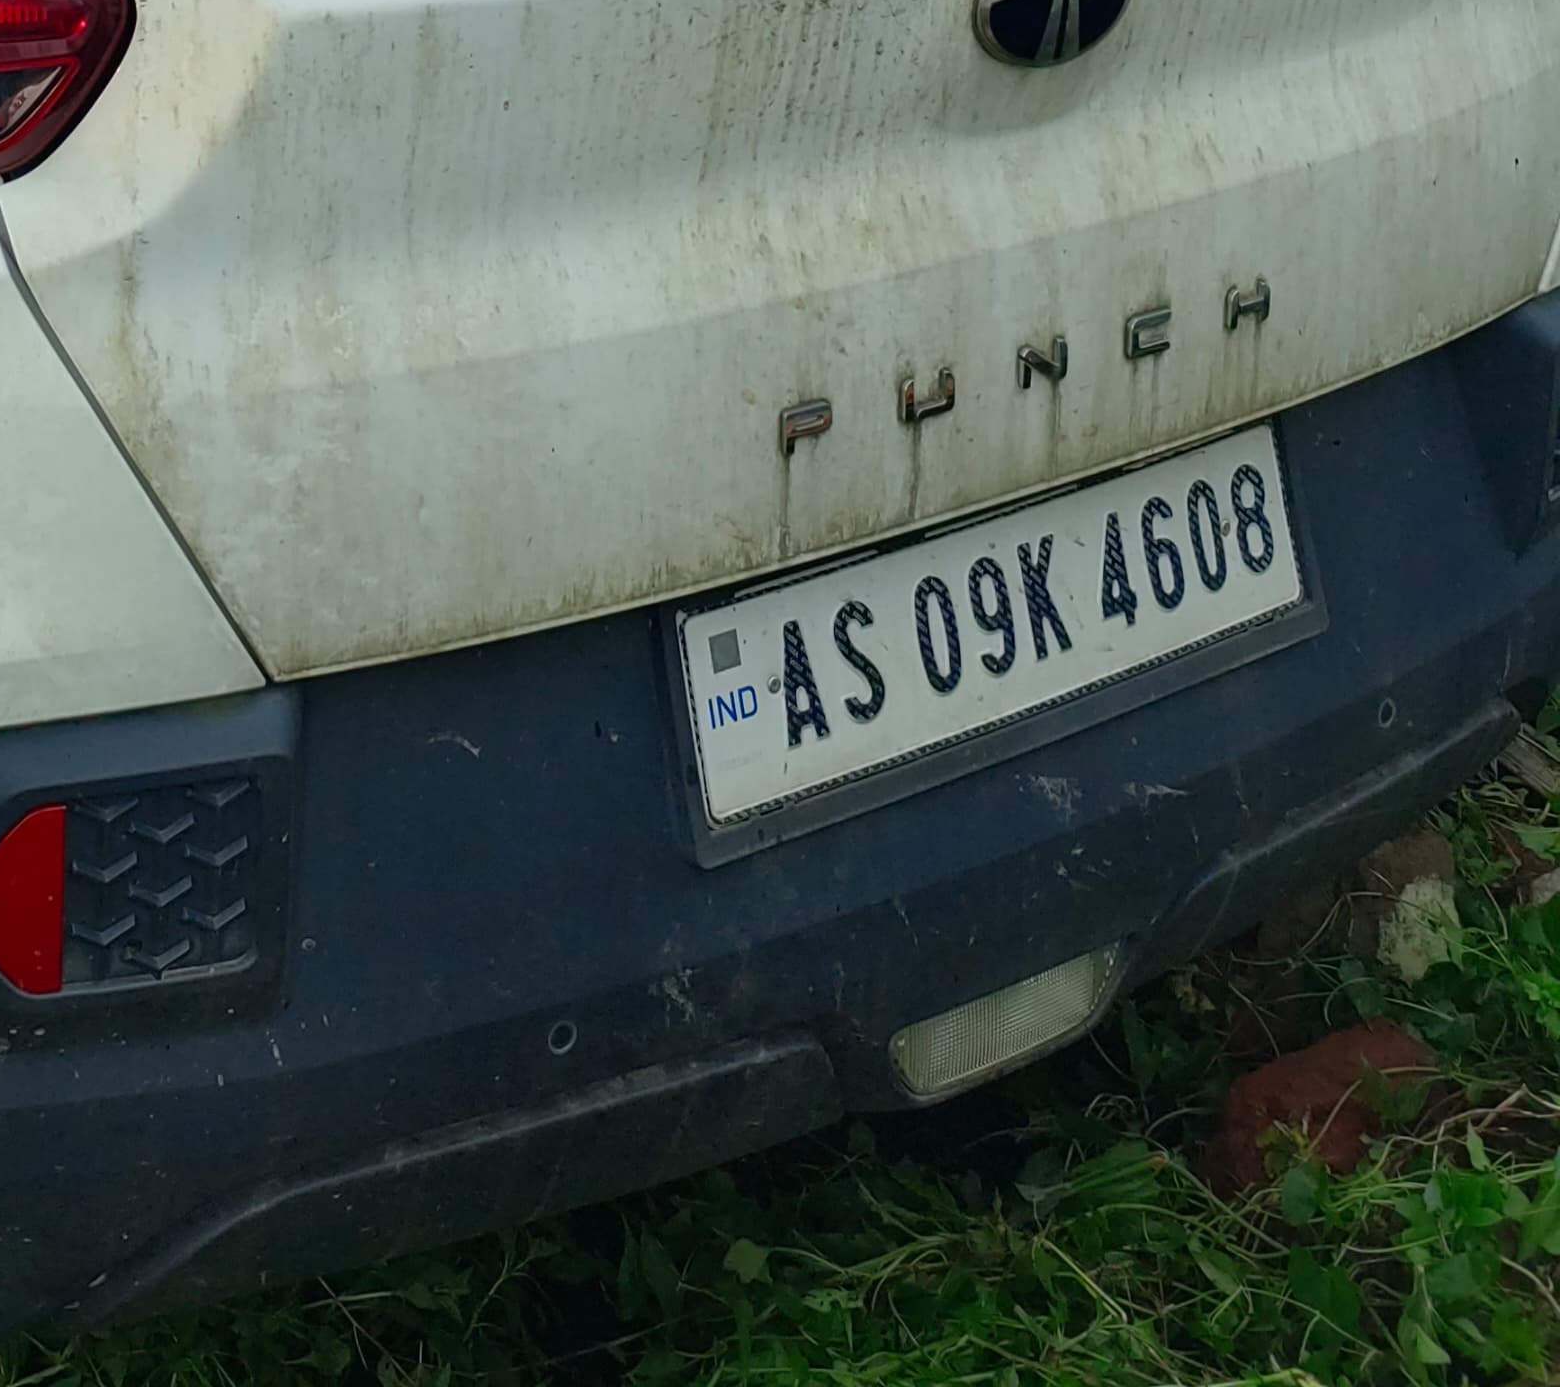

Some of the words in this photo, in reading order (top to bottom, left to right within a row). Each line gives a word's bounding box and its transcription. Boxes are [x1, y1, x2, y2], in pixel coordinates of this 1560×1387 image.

[780, 276, 1271, 455] PUNCH
[782, 600, 886, 749] AS
[914, 533, 1073, 694] 09K
[1101, 463, 1274, 627] 4608
[708, 684, 759, 730] IND
